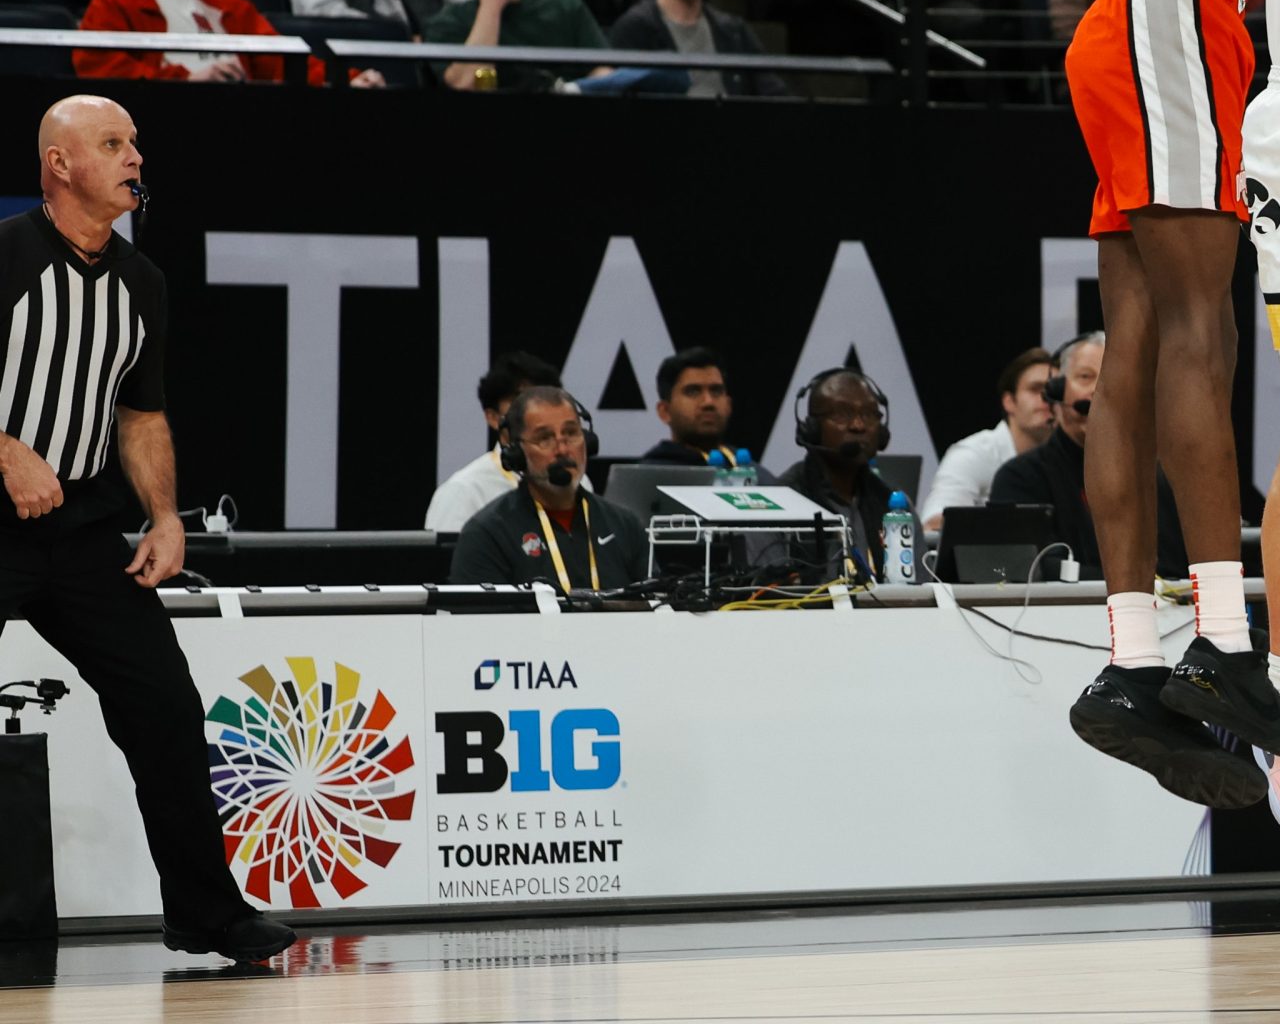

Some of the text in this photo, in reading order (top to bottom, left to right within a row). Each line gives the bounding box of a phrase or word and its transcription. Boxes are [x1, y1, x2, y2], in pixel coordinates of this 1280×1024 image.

[205, 232, 943, 530] TIAA
[506, 660, 578, 690] TIAA
[436, 809, 622, 833] BASKETBALL
[438, 839, 623, 868] TOURNAMENT
[438, 874, 622, 899] MINNEAPOLIS 2024
